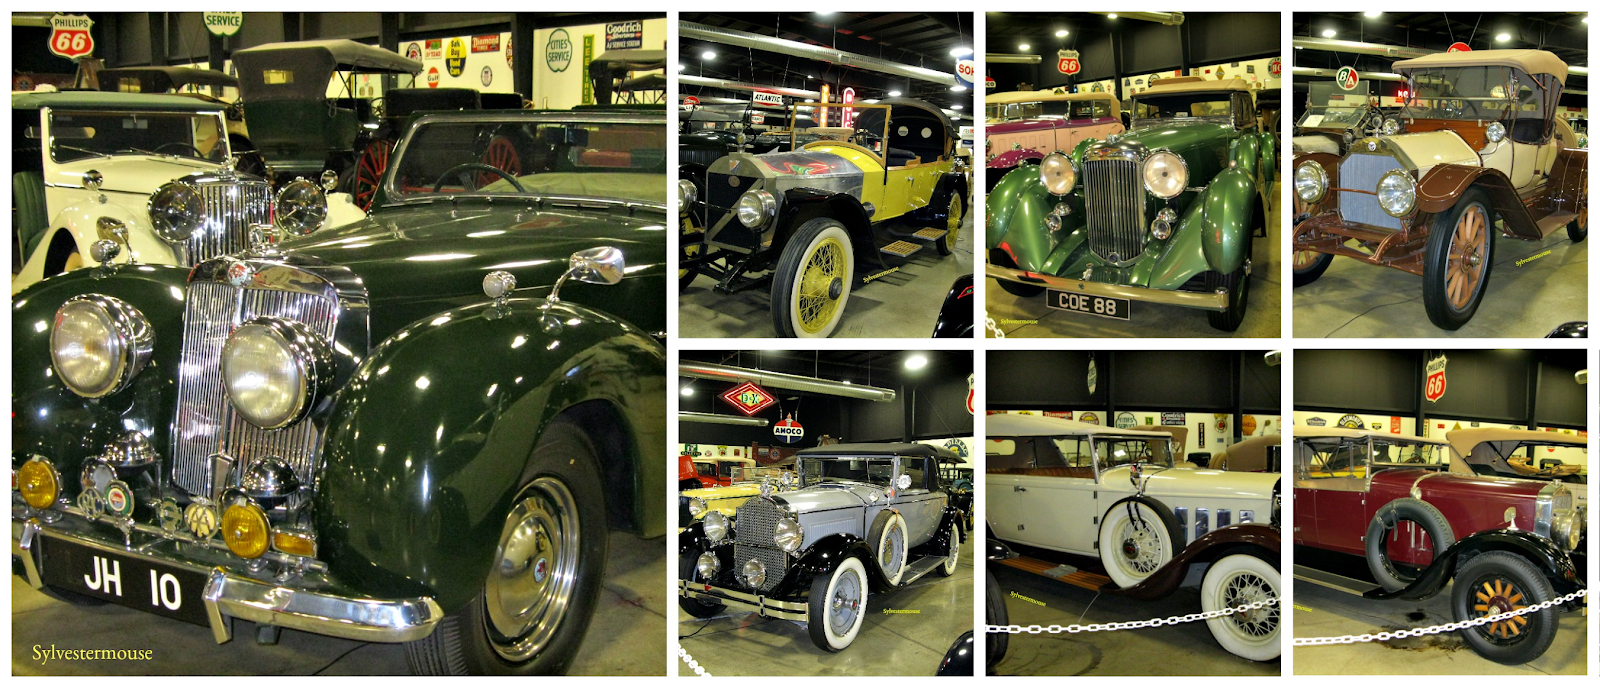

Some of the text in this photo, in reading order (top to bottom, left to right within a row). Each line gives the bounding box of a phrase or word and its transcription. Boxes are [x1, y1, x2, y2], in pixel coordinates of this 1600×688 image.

[54, 18, 89, 27] PHILLIPS
[206, 15, 240, 26] SERVICE
[606, 22, 642, 34] Goodrich
[56, 32, 87, 51] 66
[550, 39, 568, 50] CITIES
[548, 51, 570, 62] SERVICE
[1061, 60, 1077, 71] 66
[427, 74, 439, 82] Gulf
[754, 94, 781, 103] ATLANTIC
[1058, 292, 1116, 316] COE 88
[1427, 359, 1445, 373] PHILLIPS
[1427, 374, 1443, 396] 66
[775, 427, 802, 435] AMOCO
[84, 556, 182, 611] JH 10
